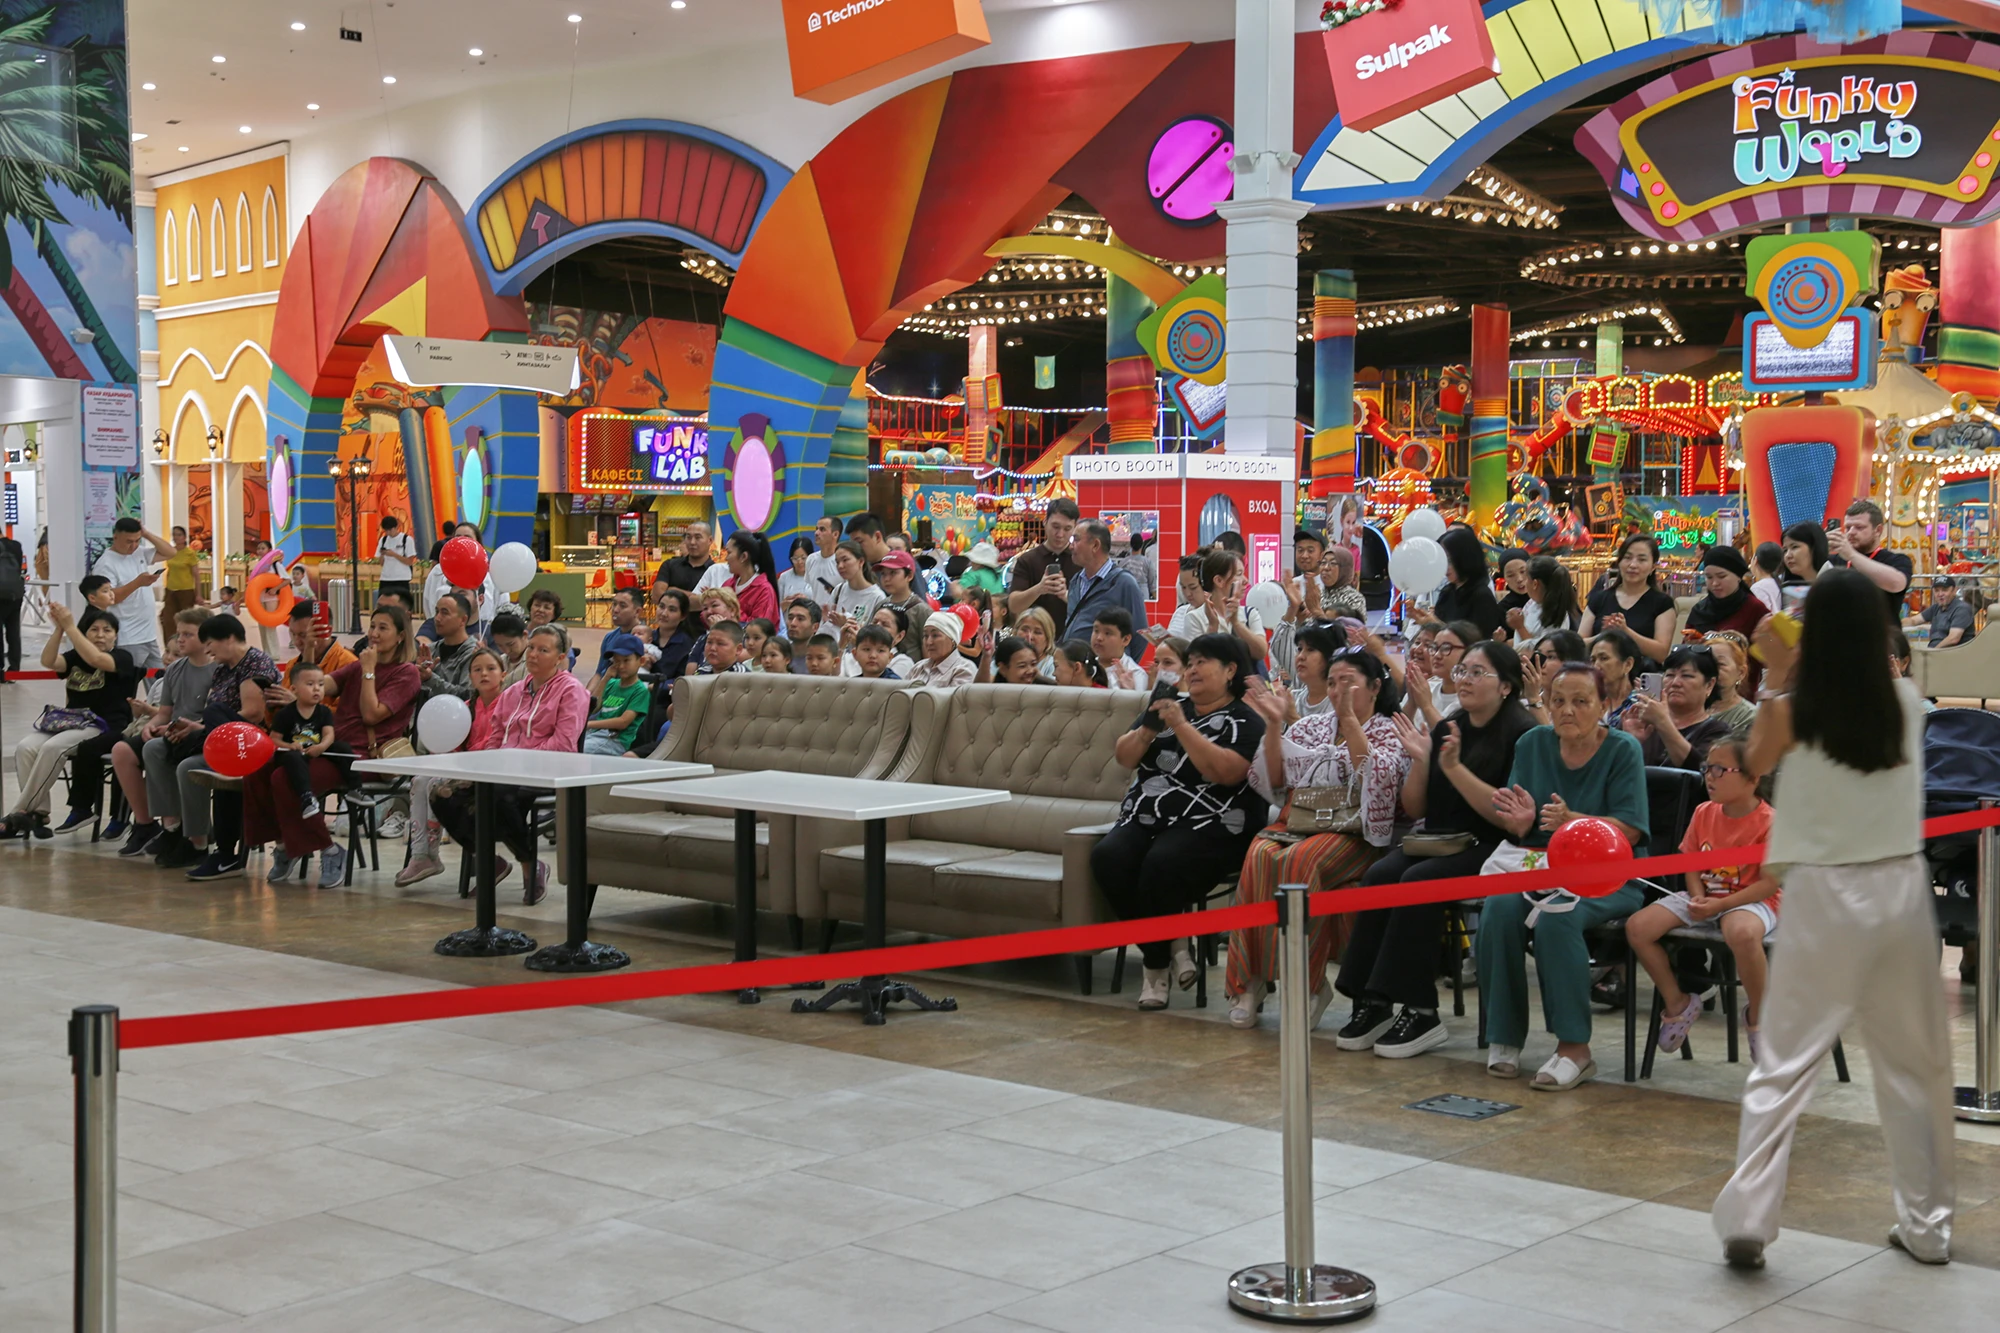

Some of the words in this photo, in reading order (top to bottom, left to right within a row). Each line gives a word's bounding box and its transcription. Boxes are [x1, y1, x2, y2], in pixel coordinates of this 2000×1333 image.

[823, 0, 892, 25] TechnoD
[1355, 24, 1452, 80] Sulpak
[1732, 75, 1917, 135] Funky
[592, 469, 644, 481] КАФЕСІ
[656, 456, 706, 481] LAB
[1075, 460, 1121, 473] PHOTO
[1126, 460, 1173, 472] BOOTH
[1206, 460, 1240, 473] PHOTO
[1244, 461, 1277, 474] BOOTH
[1248, 500, 1277, 515] ВХОД
